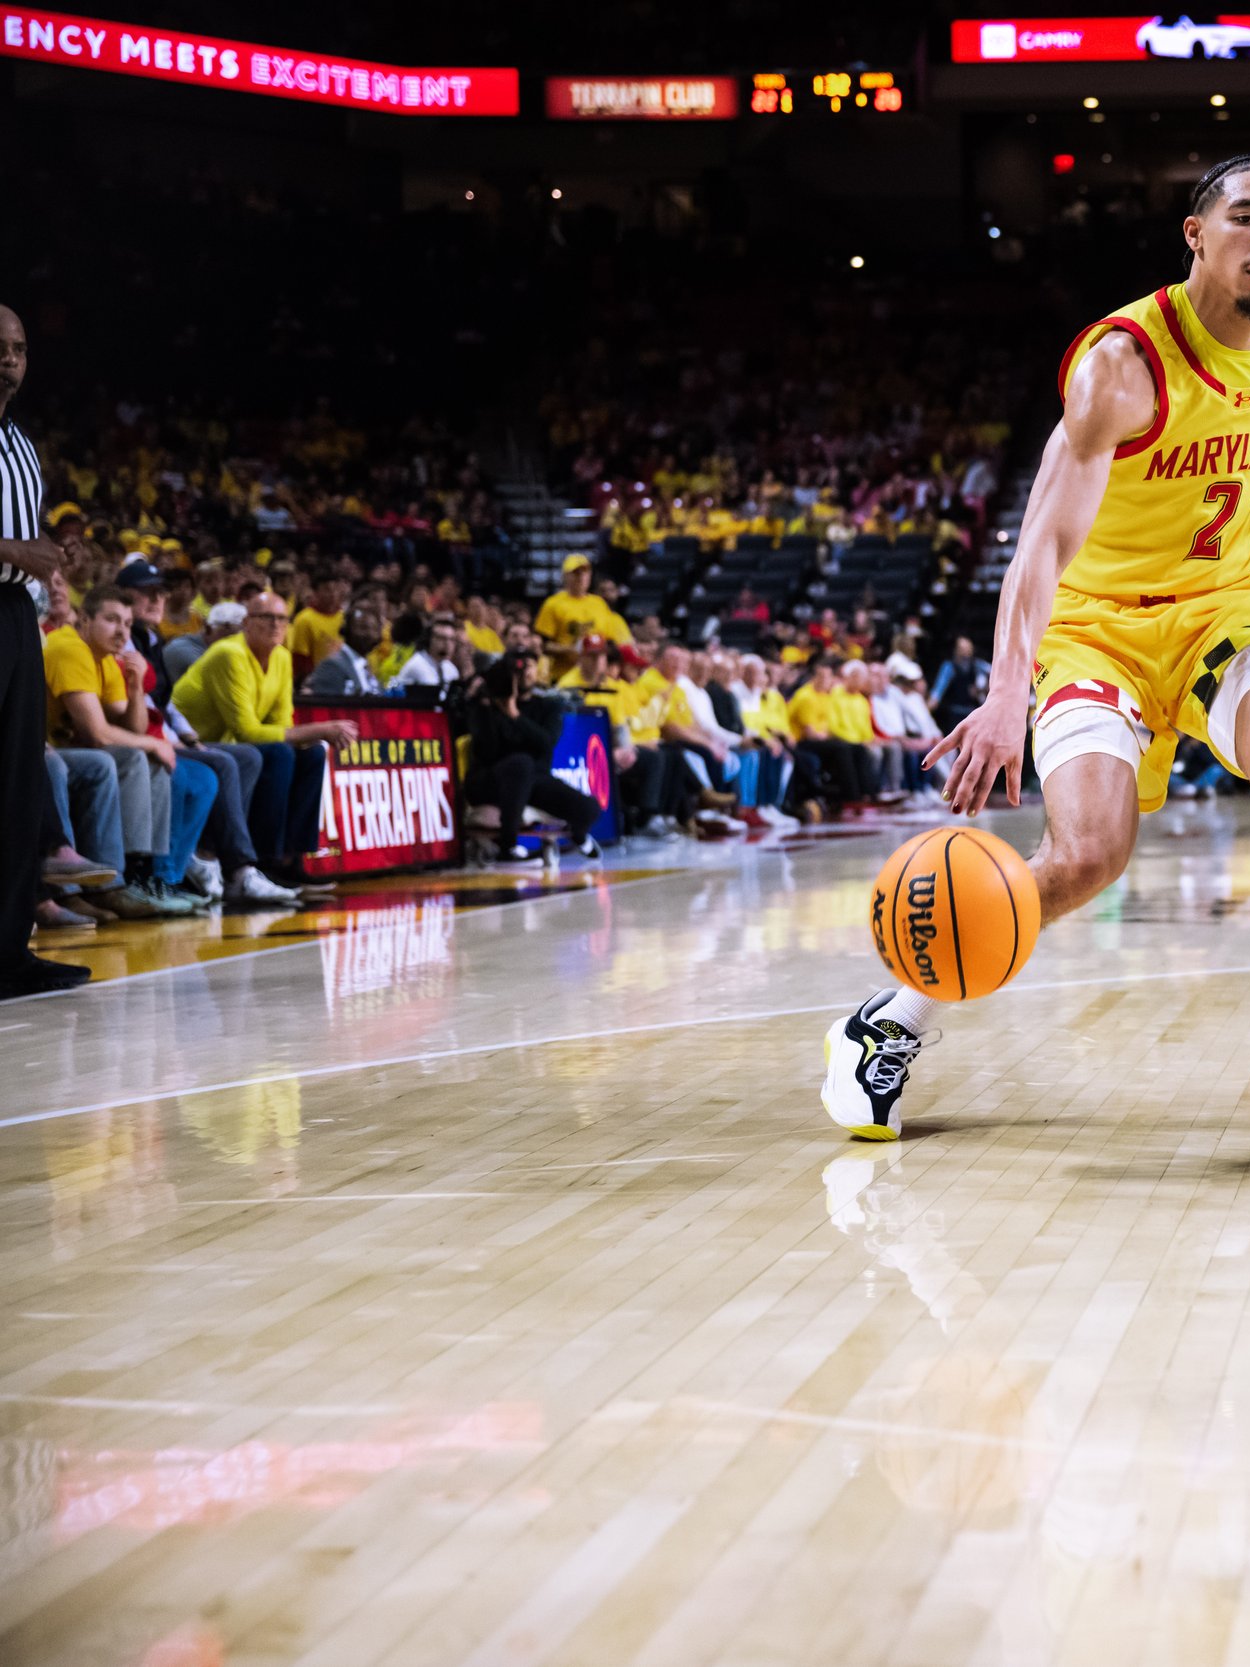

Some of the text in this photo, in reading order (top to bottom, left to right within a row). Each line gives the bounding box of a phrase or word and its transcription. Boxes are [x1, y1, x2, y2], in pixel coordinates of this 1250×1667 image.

[4, 15, 471, 107] ENCY MEETS EXCITEMENT
[1183, 481, 1243, 561] 2
[388, 740, 406, 764] OF
[413, 739, 442, 764] THE
[335, 767, 454, 852] TERRAPINS
[908, 871, 940, 986] Wilson
